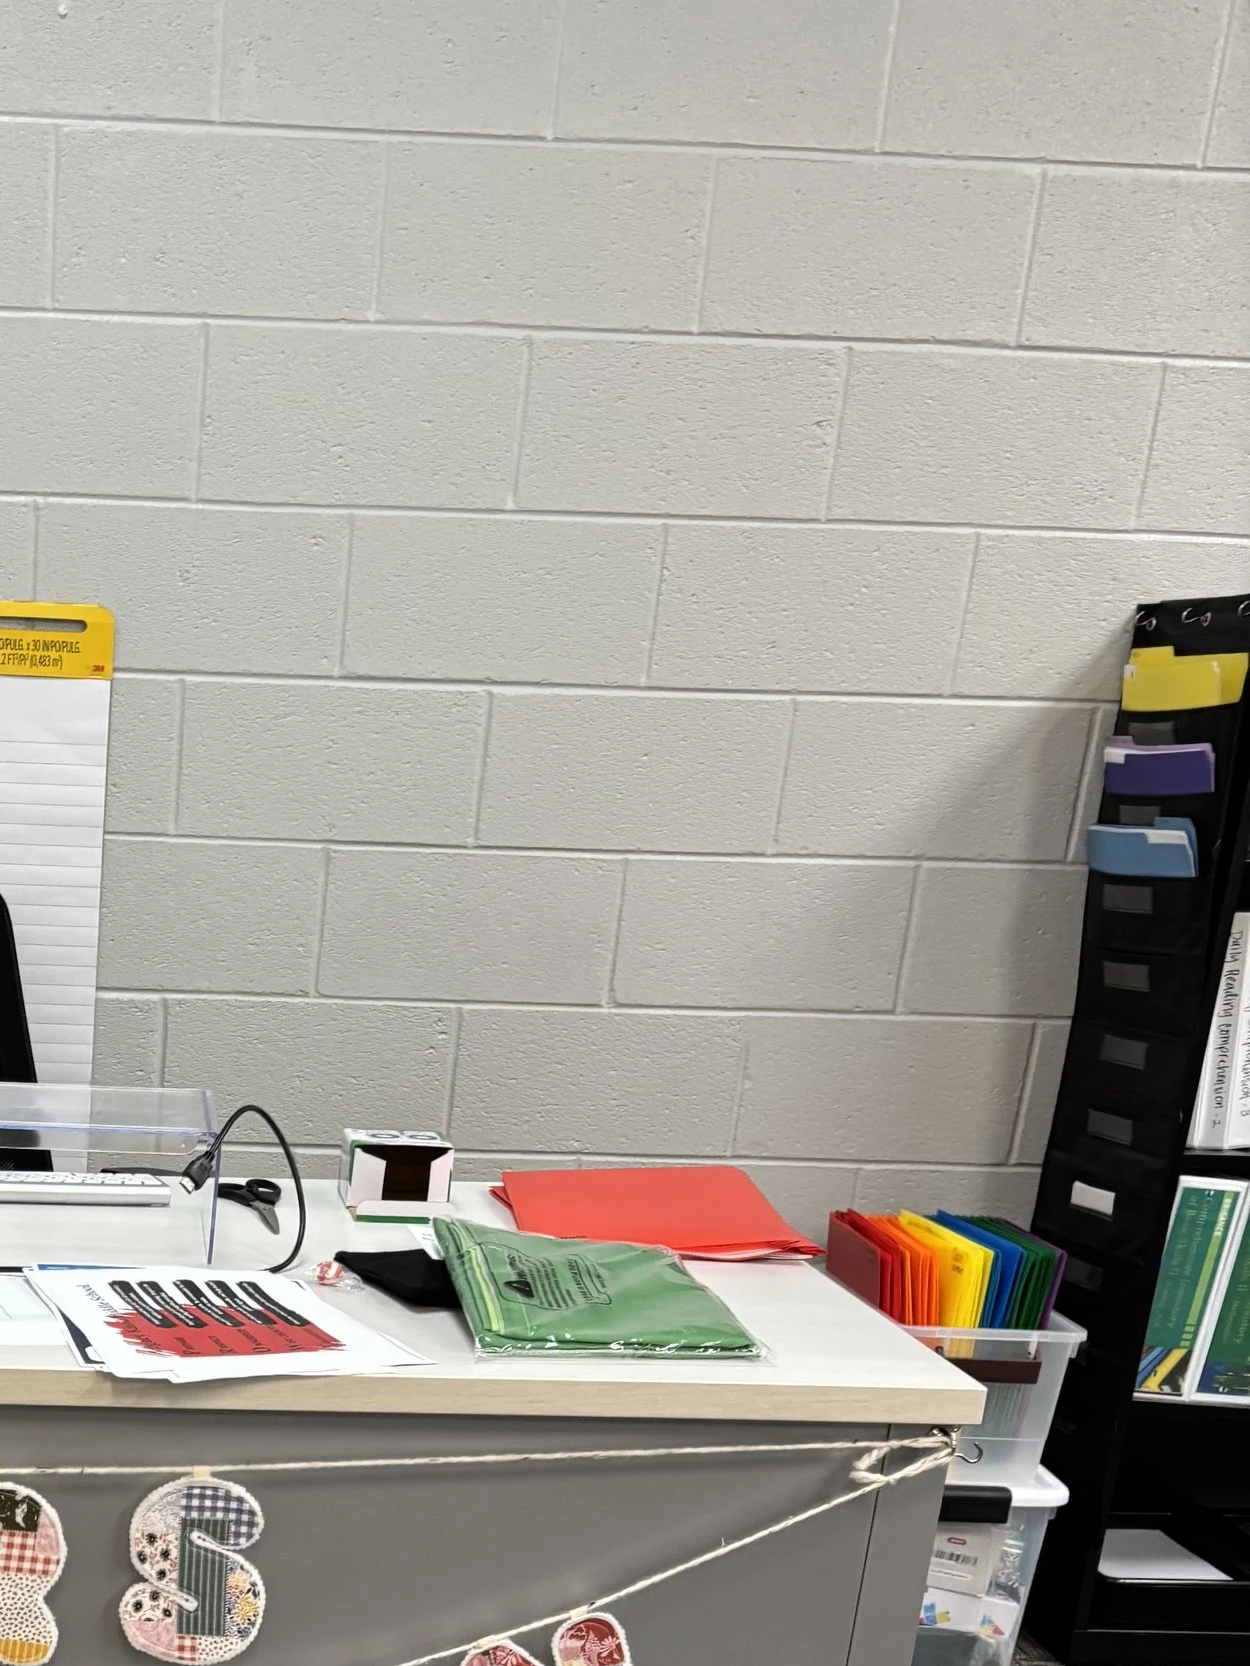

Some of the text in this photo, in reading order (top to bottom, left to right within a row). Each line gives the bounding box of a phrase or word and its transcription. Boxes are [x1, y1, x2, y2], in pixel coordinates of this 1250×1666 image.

[31, 640, 40, 651] 30
[1224, 930, 1243, 964] Daily
[1217, 969, 1240, 1018] Reading
